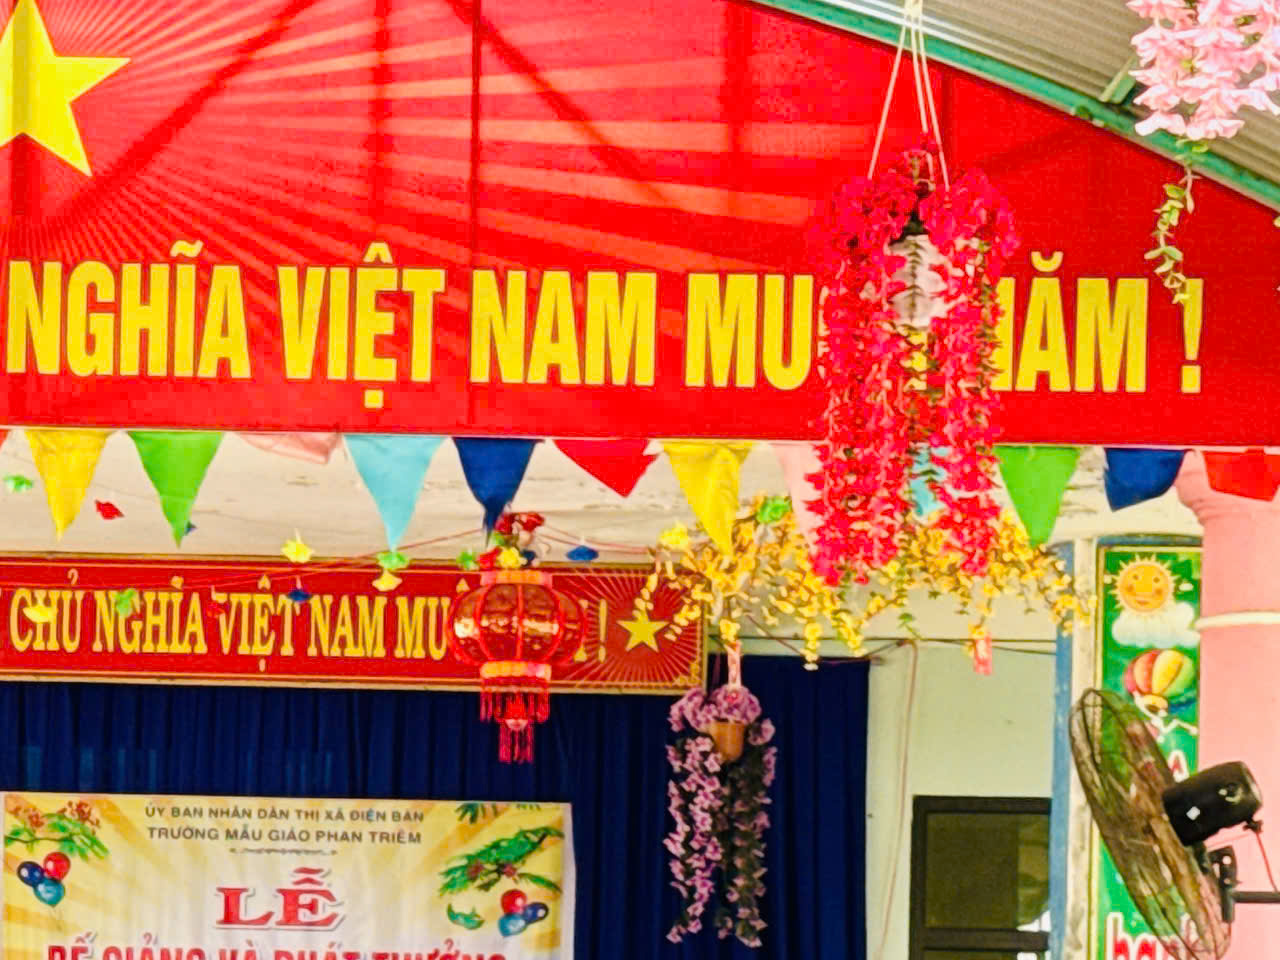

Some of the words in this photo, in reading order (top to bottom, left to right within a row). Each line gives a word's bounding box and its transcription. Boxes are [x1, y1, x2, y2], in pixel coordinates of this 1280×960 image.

[7, 239, 252, 380] NGHĨA
[277, 243, 446, 409] VIỆT
[471, 269, 657, 386] NAM
[684, 272, 813, 390] MU
[10, 568, 86, 653] CHỦ
[91, 575, 208, 655] NGHĨA
[213, 574, 302, 673] VIỆT
[307, 593, 388, 657] NAM
[394, 596, 452, 661] MU
[171, 806, 204, 819] BAN
[315, 830, 363, 844] PHAN
[216, 866, 343, 929] LỄ
